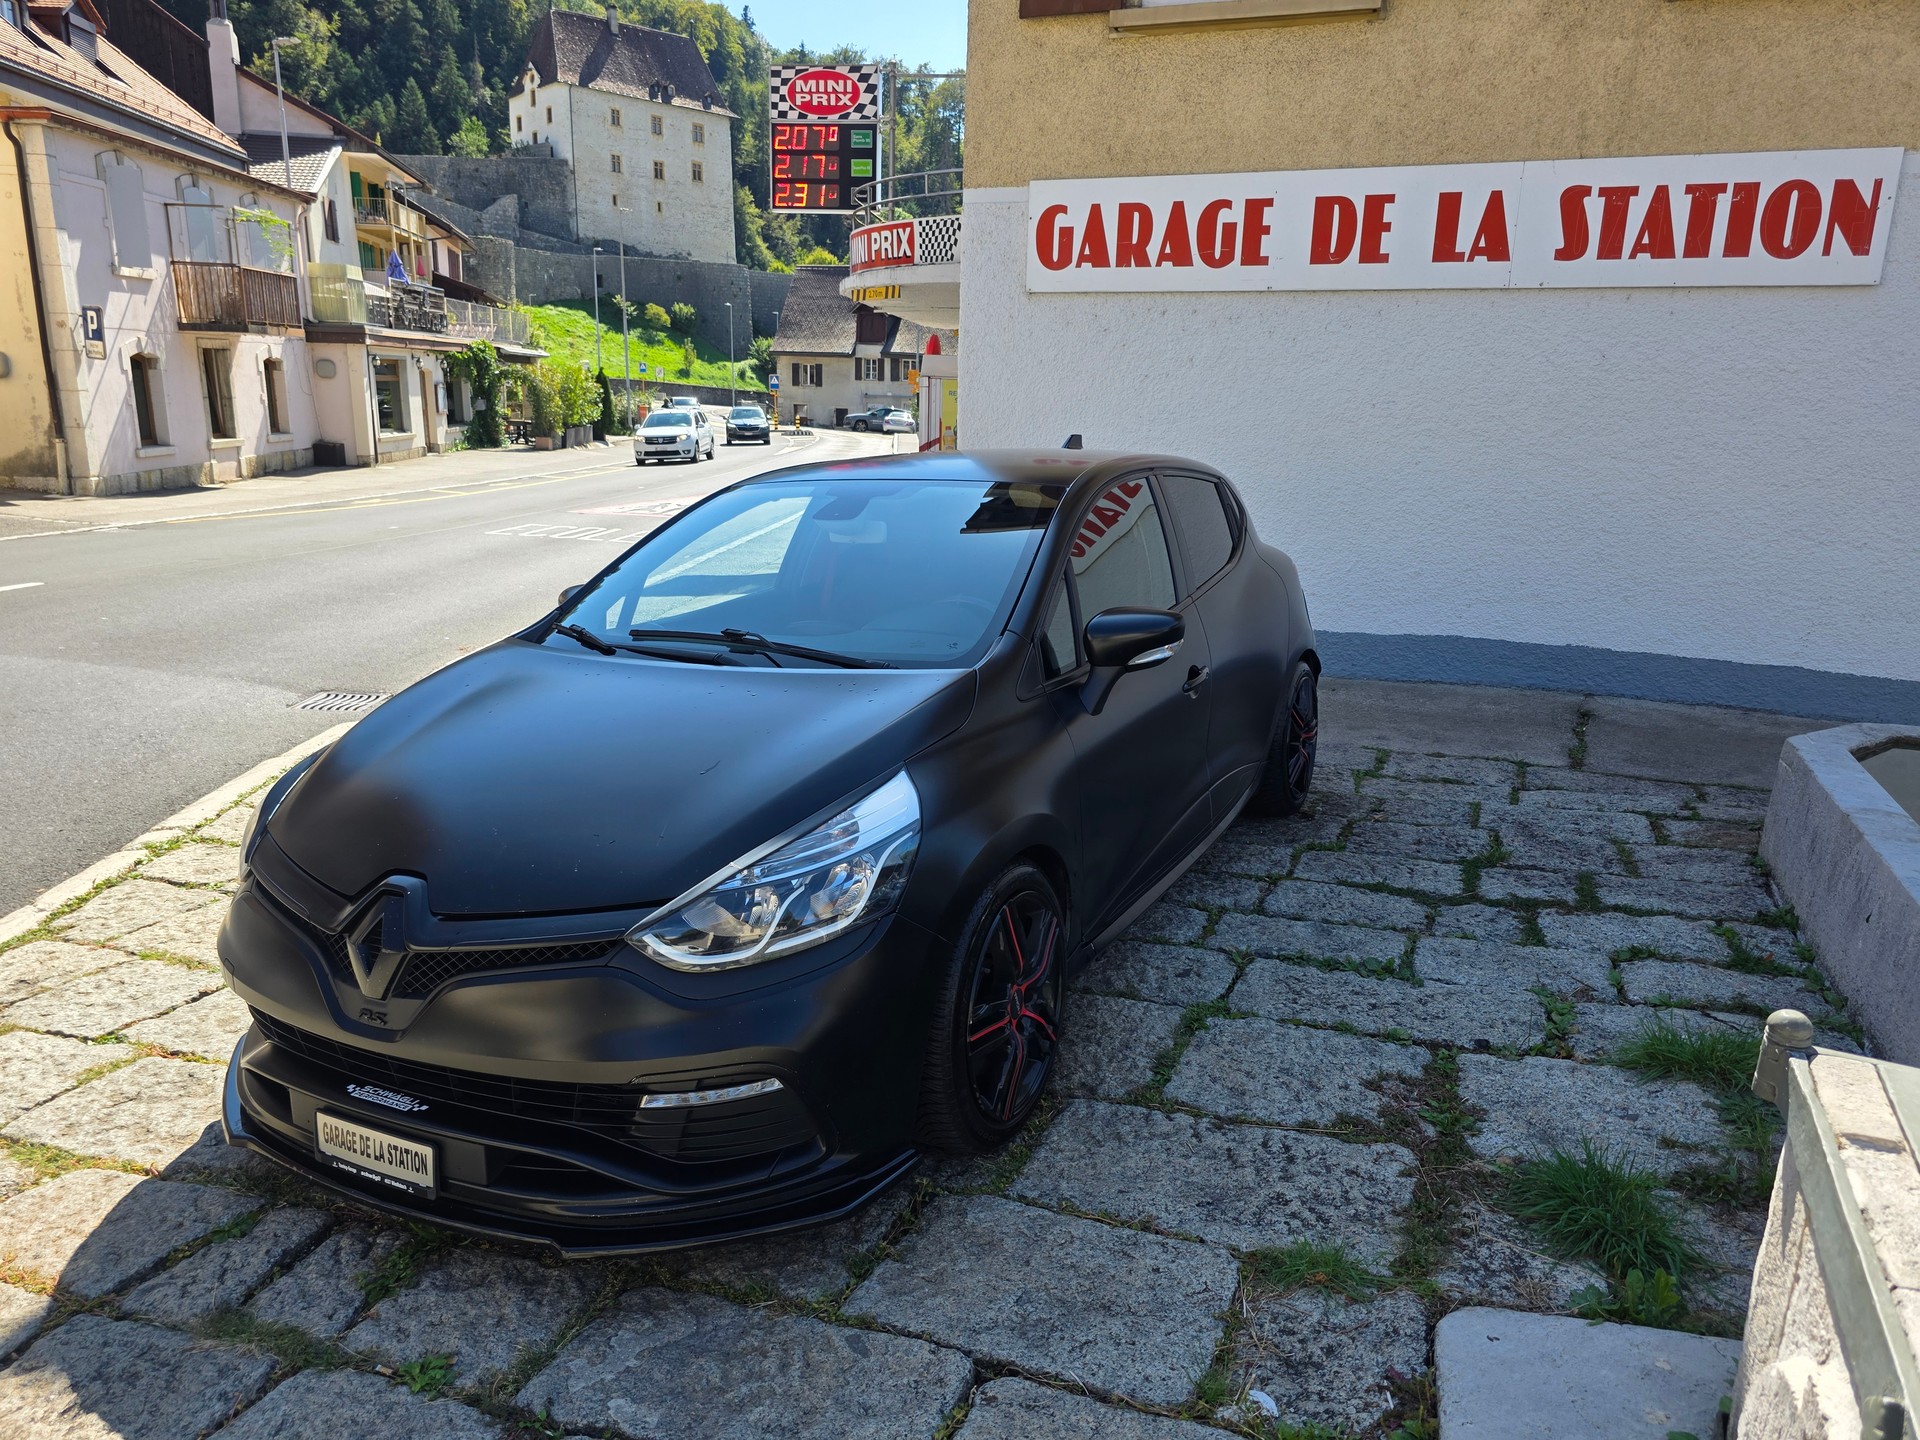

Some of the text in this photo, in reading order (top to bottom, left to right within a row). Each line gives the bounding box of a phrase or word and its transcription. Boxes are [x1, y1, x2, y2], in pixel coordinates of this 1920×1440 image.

[795, 79, 853, 92] MINI
[795, 93, 854, 106] PRIX
[1034, 177, 1884, 271] GARAGE DE LA STATION
[871, 227, 912, 262] PRIX
[86, 310, 98, 338] P
[352, 1091, 411, 1111] PERFORMANCE
[360, 1085, 420, 1106] SCHWÄGLI
[322, 1121, 358, 1154] GARAGE
[358, 1134, 371, 1159] DE
[372, 1138, 385, 1163] LA
[387, 1143, 428, 1176] STATION
